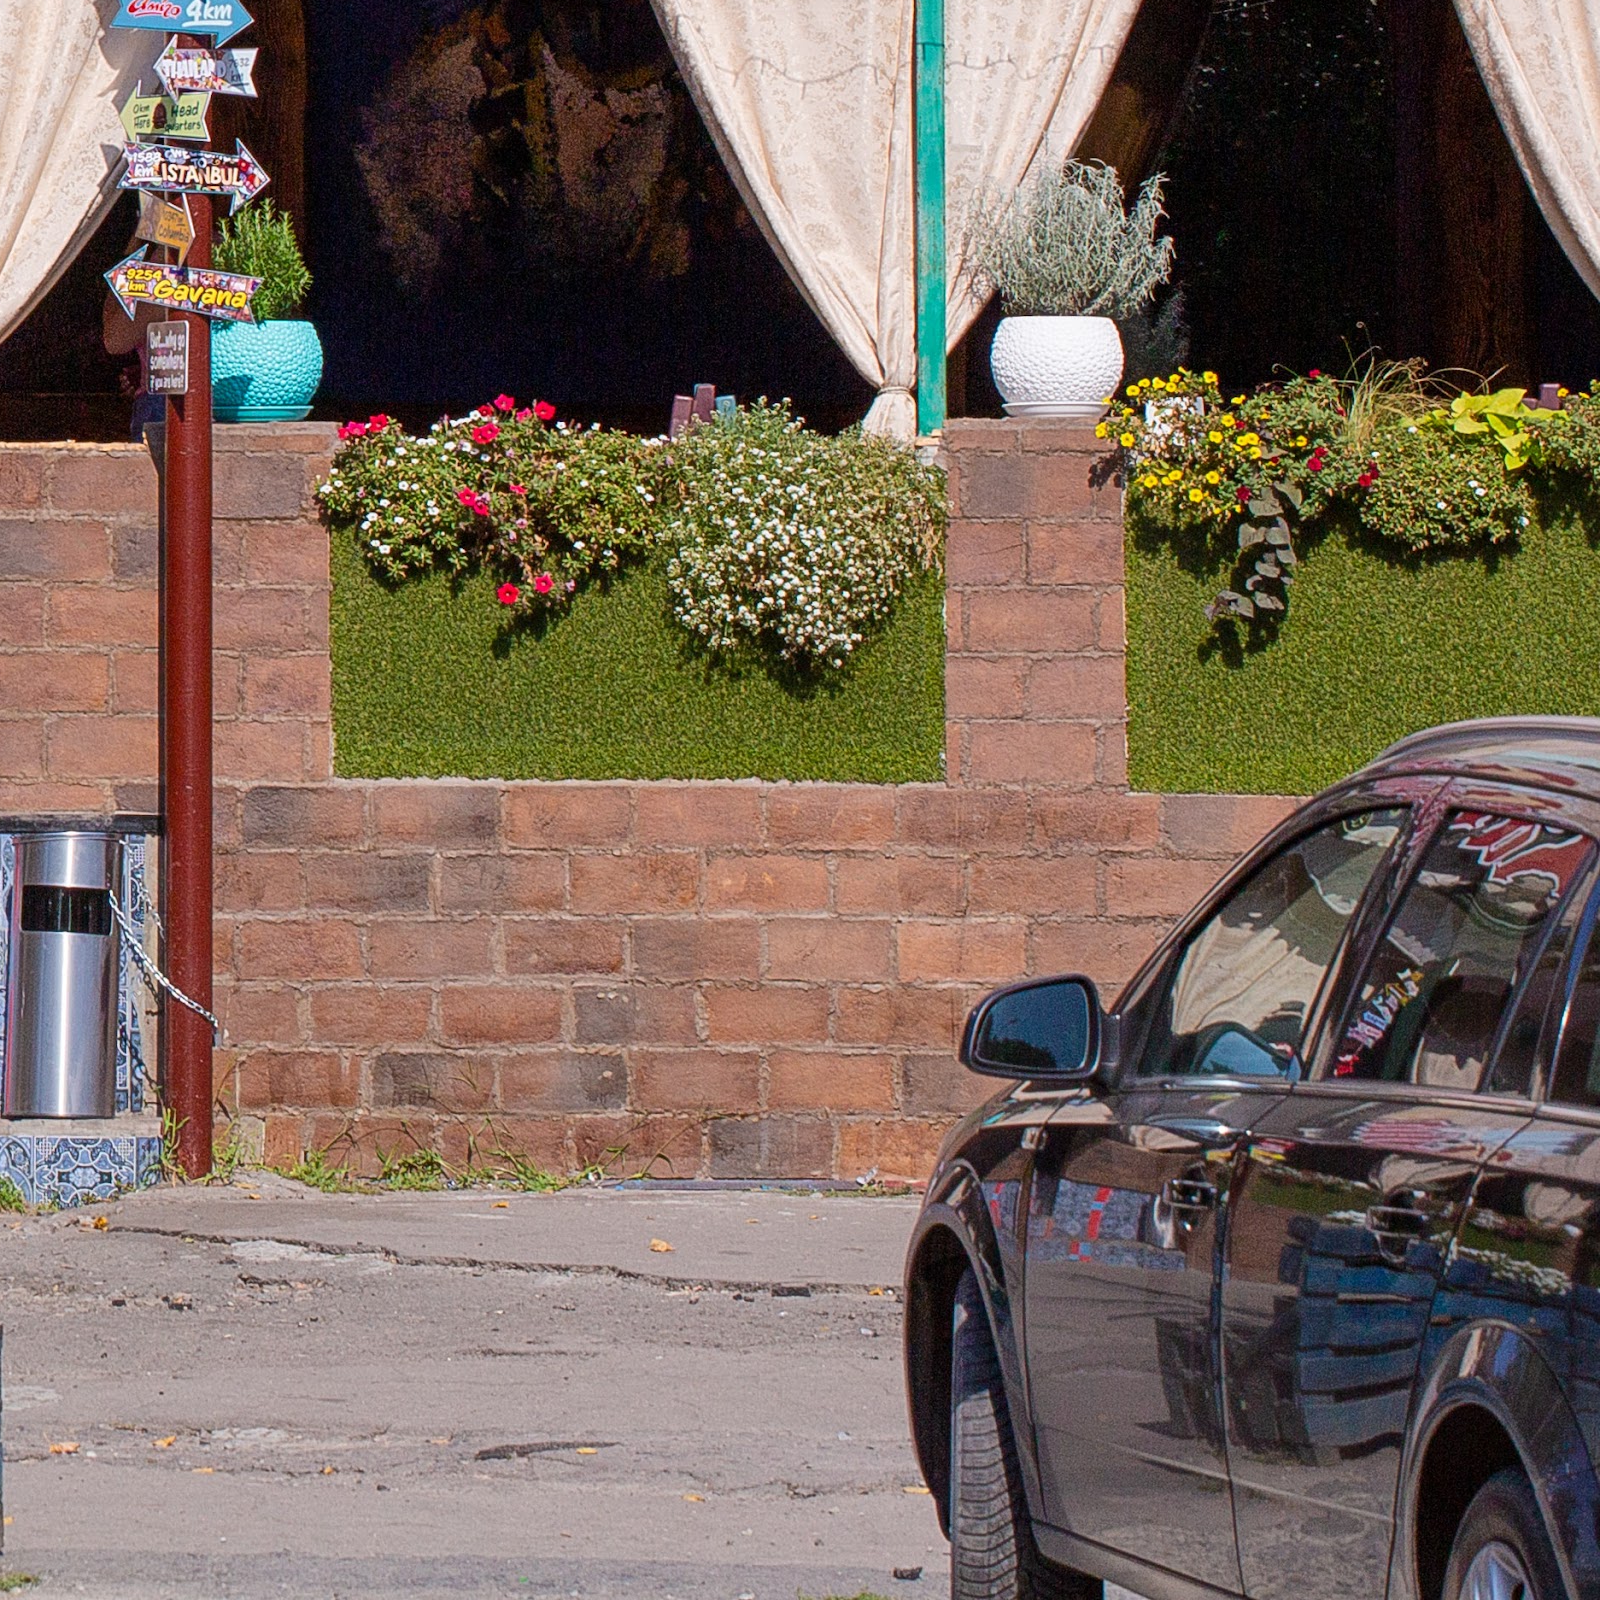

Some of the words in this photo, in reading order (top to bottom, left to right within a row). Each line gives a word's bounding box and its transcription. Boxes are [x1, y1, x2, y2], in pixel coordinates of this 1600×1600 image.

[162, 58, 227, 79] THAILAND
[170, 101, 200, 118] Head
[164, 119, 202, 134] quarters
[161, 163, 244, 187] ISTANBUL
[126, 268, 164, 282] 9254
[128, 281, 146, 292] km
[153, 279, 248, 309] Gavana
